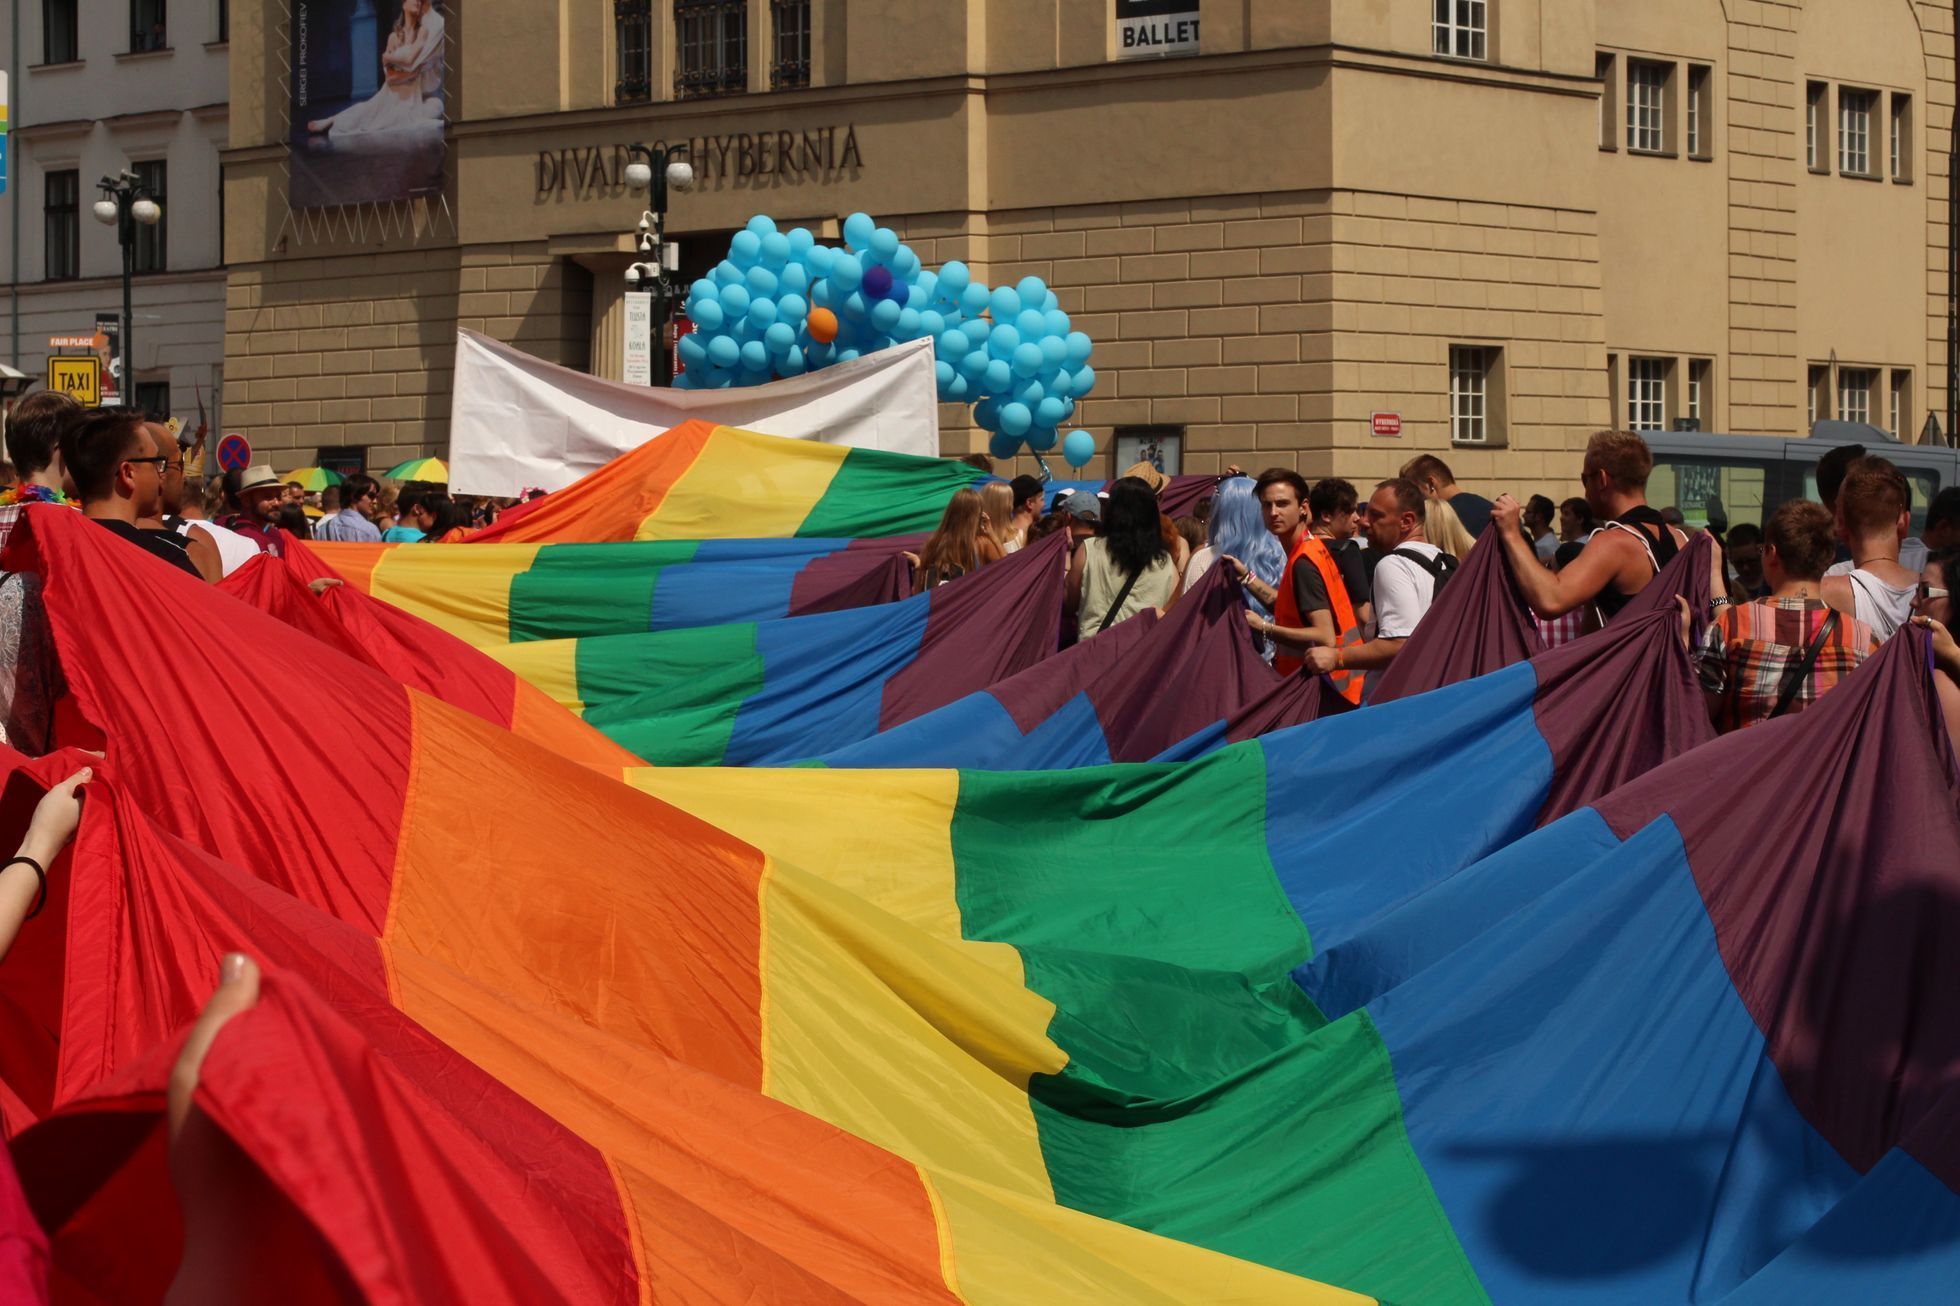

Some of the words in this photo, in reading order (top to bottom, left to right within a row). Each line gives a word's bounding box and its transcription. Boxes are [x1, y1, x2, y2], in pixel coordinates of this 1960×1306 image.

[299, 3, 307, 65] PROKOFIEV
[1123, 20, 1199, 48] BALLET
[299, 68, 307, 106] SERGEI
[539, 139, 669, 192] DIVAD
[690, 121, 865, 181] HYBERNIA
[50, 337, 69, 346] FAIR
[69, 337, 94, 346] PLACE
[58, 372, 90, 391] TAXI
